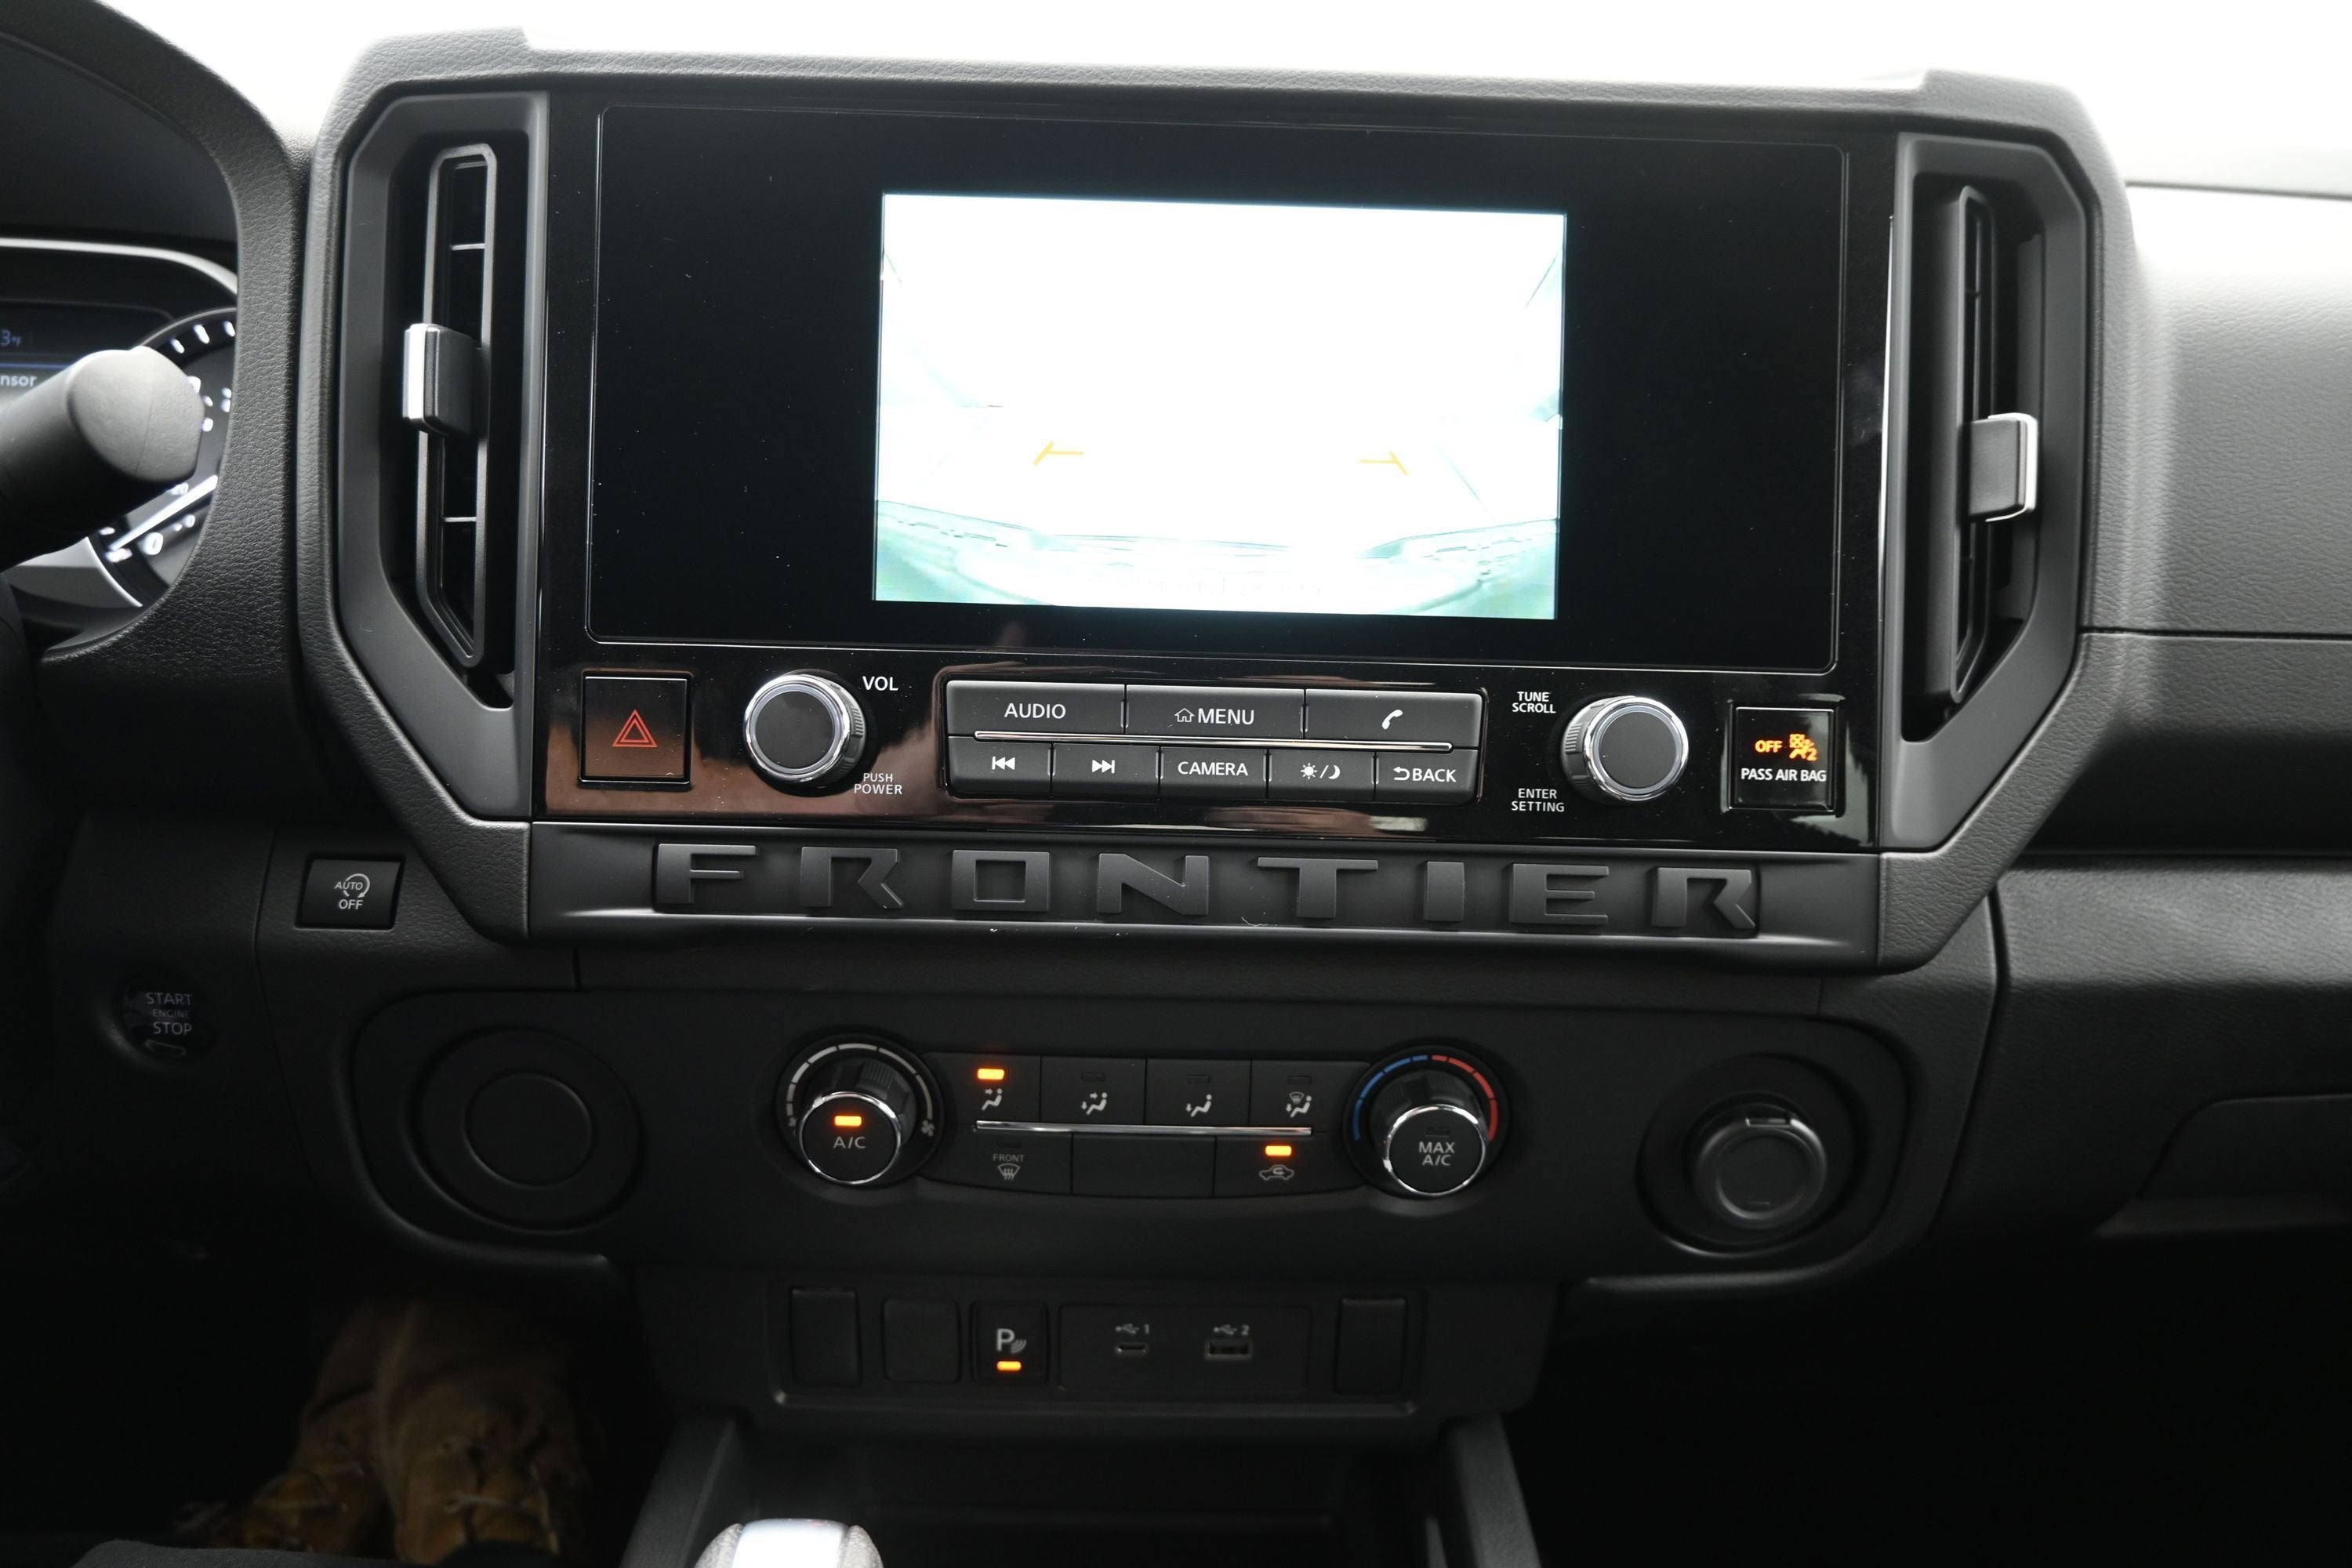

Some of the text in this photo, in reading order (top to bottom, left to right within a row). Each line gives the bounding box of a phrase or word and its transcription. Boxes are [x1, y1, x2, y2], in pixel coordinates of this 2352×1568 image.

[862, 676, 899, 691] VOL
[1517, 691, 1550, 702] TUNE
[1004, 702, 1066, 720] AUDIO
[1512, 702, 1557, 714] SCROLL
[1197, 707, 1254, 726] MENU
[1754, 739, 1783, 753] OFF
[1178, 761, 1249, 776] CAMERA
[1412, 768, 1457, 782] BACK
[1740, 768, 1828, 782] PASS AIR BAG
[863, 772, 894, 782] PUSH
[854, 783, 903, 795] POWER
[1518, 788, 1558, 800] ENTER
[1511, 800, 1566, 812] SETTING
[334, 881, 364, 891] AUTO
[655, 843, 1758, 930] FRONTIER
[338, 898, 364, 910] OFF
[145, 992, 192, 1005] START
[151, 1008, 190, 1018] ENGINE
[153, 1022, 192, 1035] STOP
[833, 1135, 866, 1149] A/C
[1419, 1141, 1455, 1154] MAX
[993, 1153, 1025, 1163] FRONT
[1422, 1154, 1451, 1167] A/C
[1143, 1323, 1150, 1334] 1
[1241, 1324, 1250, 1336] 2
